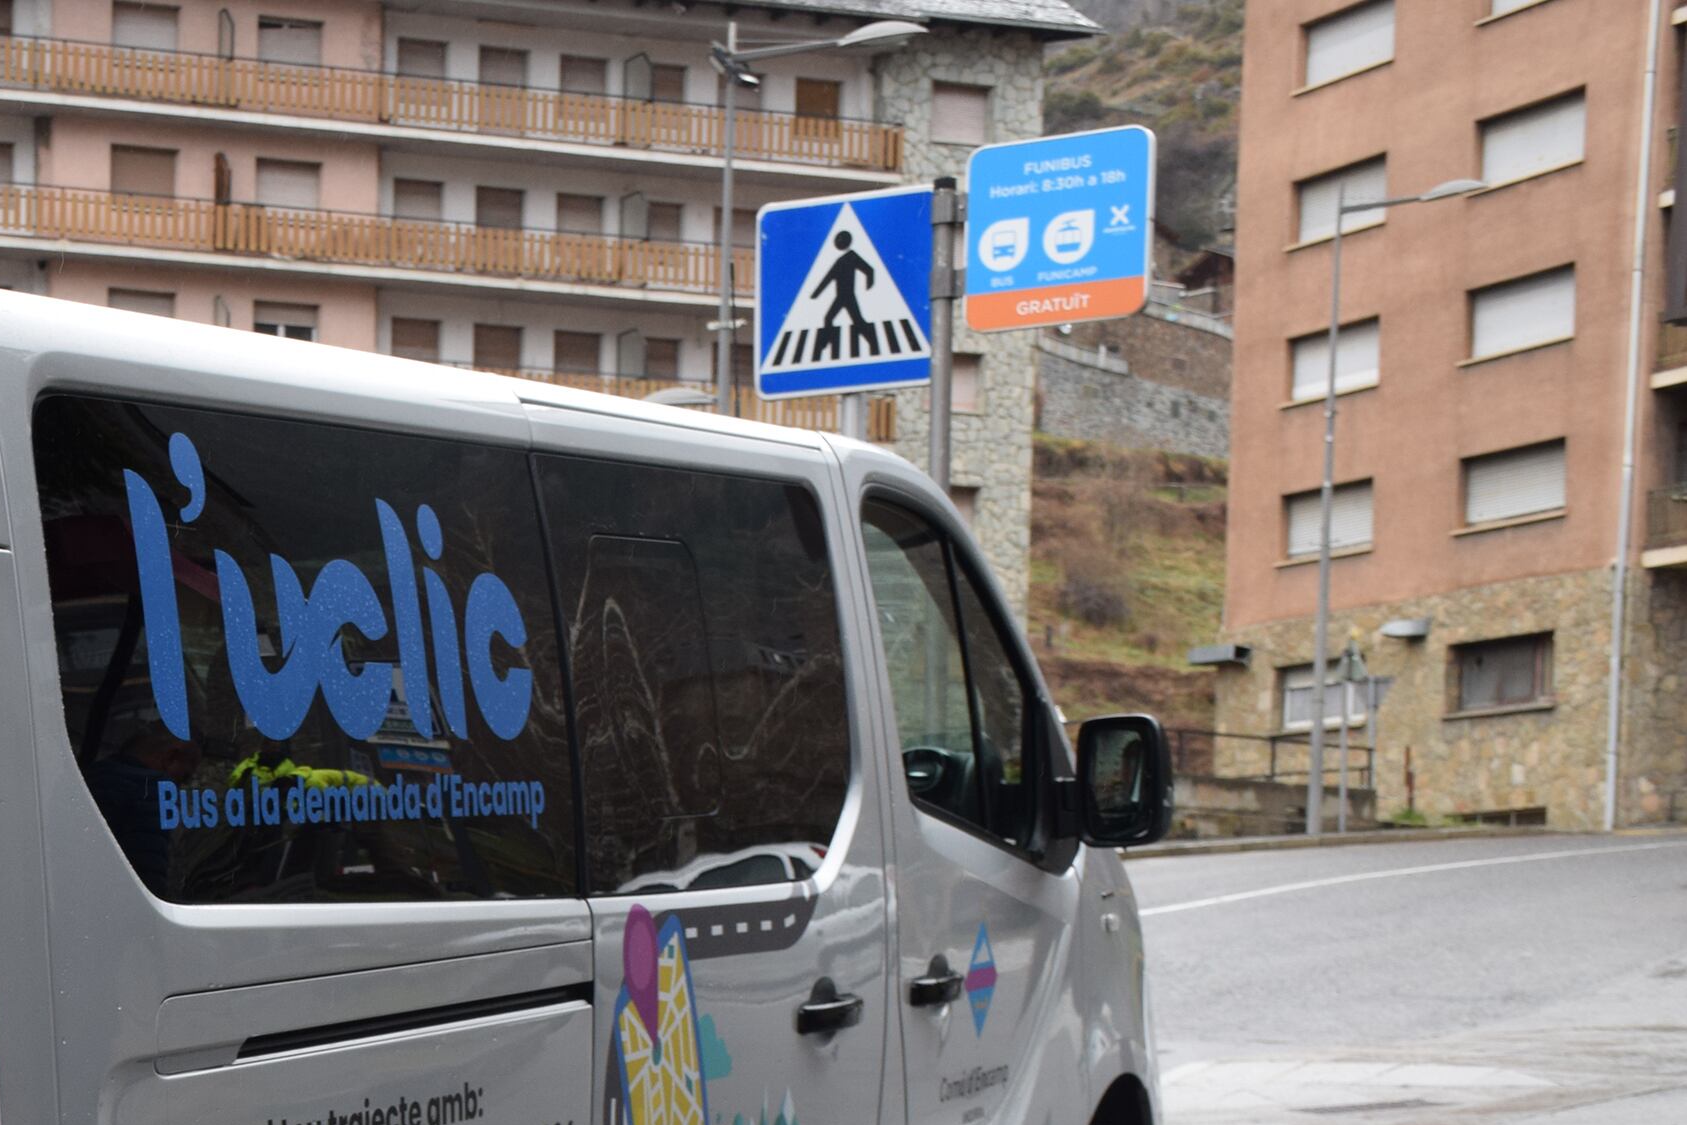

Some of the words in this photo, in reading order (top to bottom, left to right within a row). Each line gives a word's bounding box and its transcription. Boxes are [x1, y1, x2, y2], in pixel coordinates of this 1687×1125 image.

[1023, 155, 1093, 175] FUNIBUS
[989, 182, 1040, 199] Horari:
[1042, 176, 1085, 193] 8:30h
[1087, 177, 1097, 187] a
[990, 276, 1015, 288] BUS
[1037, 266, 1098, 282] FUNICAMP
[1015, 293, 1091, 316] GRATUÏT
[123, 431, 533, 741] l'uclic
[158, 780, 219, 830] Bus
[224, 785, 246, 827] a
[251, 775, 280, 827] la
[286, 774, 423, 824] demanda
[425, 772, 545, 830] d'Encamp
